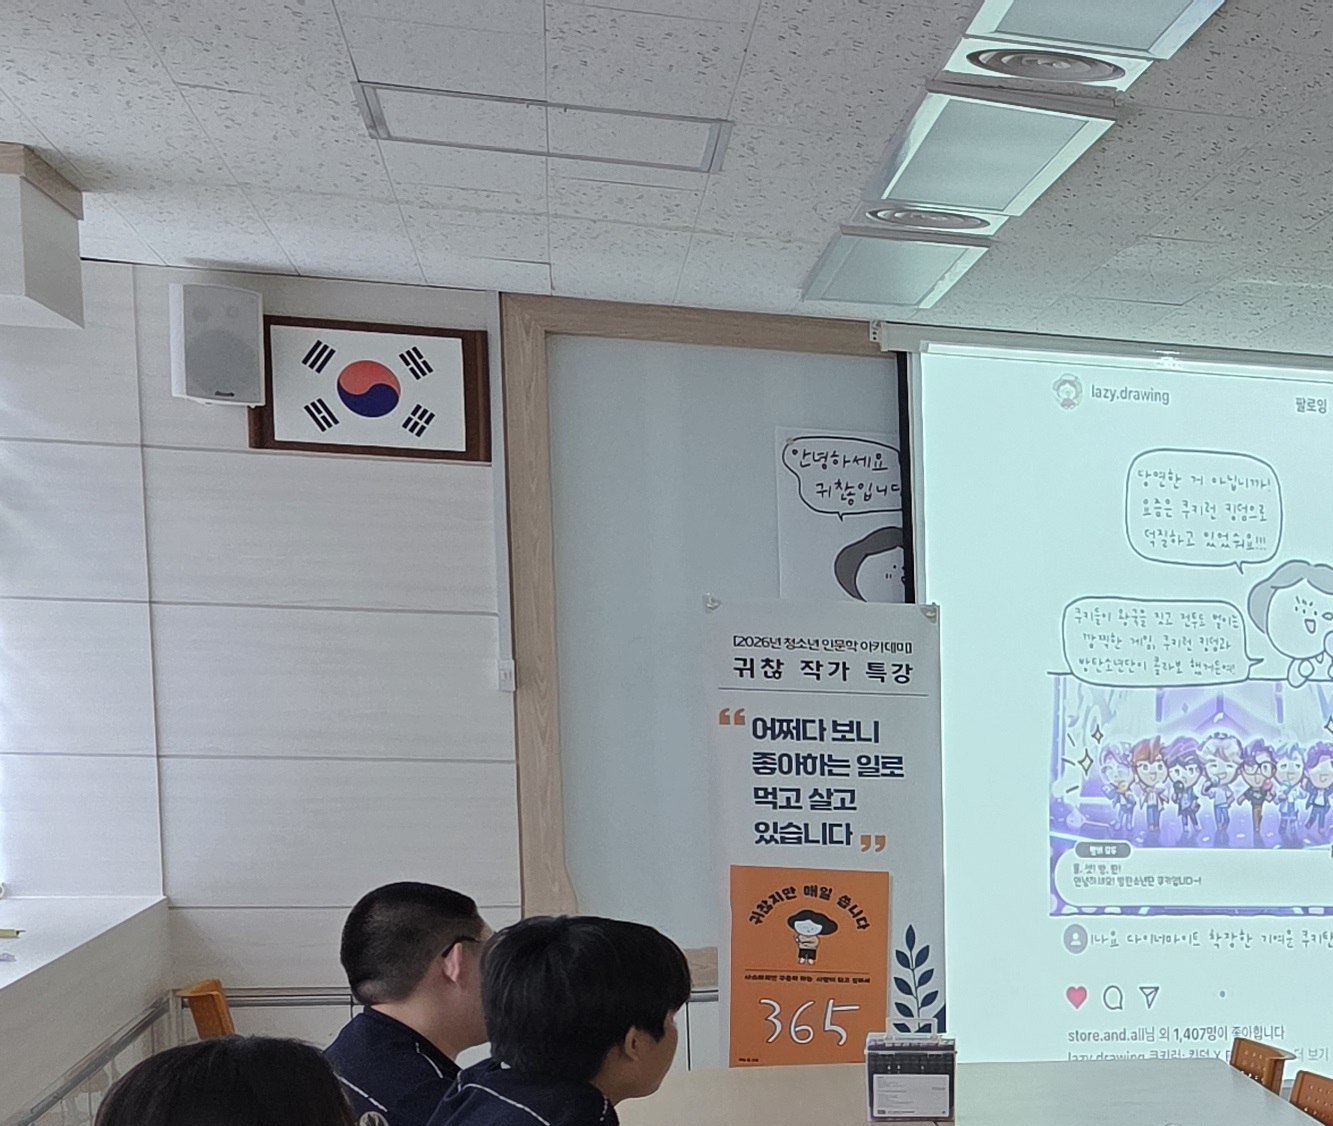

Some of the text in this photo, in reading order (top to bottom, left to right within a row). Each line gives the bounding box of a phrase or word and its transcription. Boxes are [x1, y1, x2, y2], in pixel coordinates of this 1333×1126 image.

[1091, 384, 1327, 415] lazy.drawing 팔로잉
[791, 448, 889, 471] 안녕하세요
[1137, 468, 1182, 489] 당연한
[1191, 475, 1203, 485] 거
[1142, 498, 1267, 522] 요즘은 쿠키런 킹덤으로
[1144, 529, 1195, 548] 덕질하고
[1074, 607, 1111, 626] 쿠키들이
[1118, 608, 1147, 628] 왕국을
[1180, 611, 1206, 629] 전투도
[783, 637, 820, 651] 청소년
[821, 638, 858, 653] 인문학
[1082, 633, 1122, 649] 깜찍한
[1163, 634, 1192, 652] 쿠키런
[733, 657, 913, 684] 귀찮 작가 특강
[1079, 657, 1147, 674] 방탄소년단이
[1153, 656, 1183, 676] 콜라보
[831, 719, 880, 744] 보니
[752, 751, 905, 778] 좋아하는 일로
[753, 786, 857, 811] 먹고 살고
[748, 884, 871, 930] 귀찮지만 매일 씁니다
[1127, 931, 1201, 947] 다이너마이트
[1209, 928, 1253, 949] 착장한
[759, 998, 860, 1046] 365
[1068, 1026, 1155, 1043] store.and.all님
[1158, 1026, 1170, 1042] 외
[1173, 1025, 1228, 1043] 1,407명이
[1308, 1048, 1329, 1061] 보기
